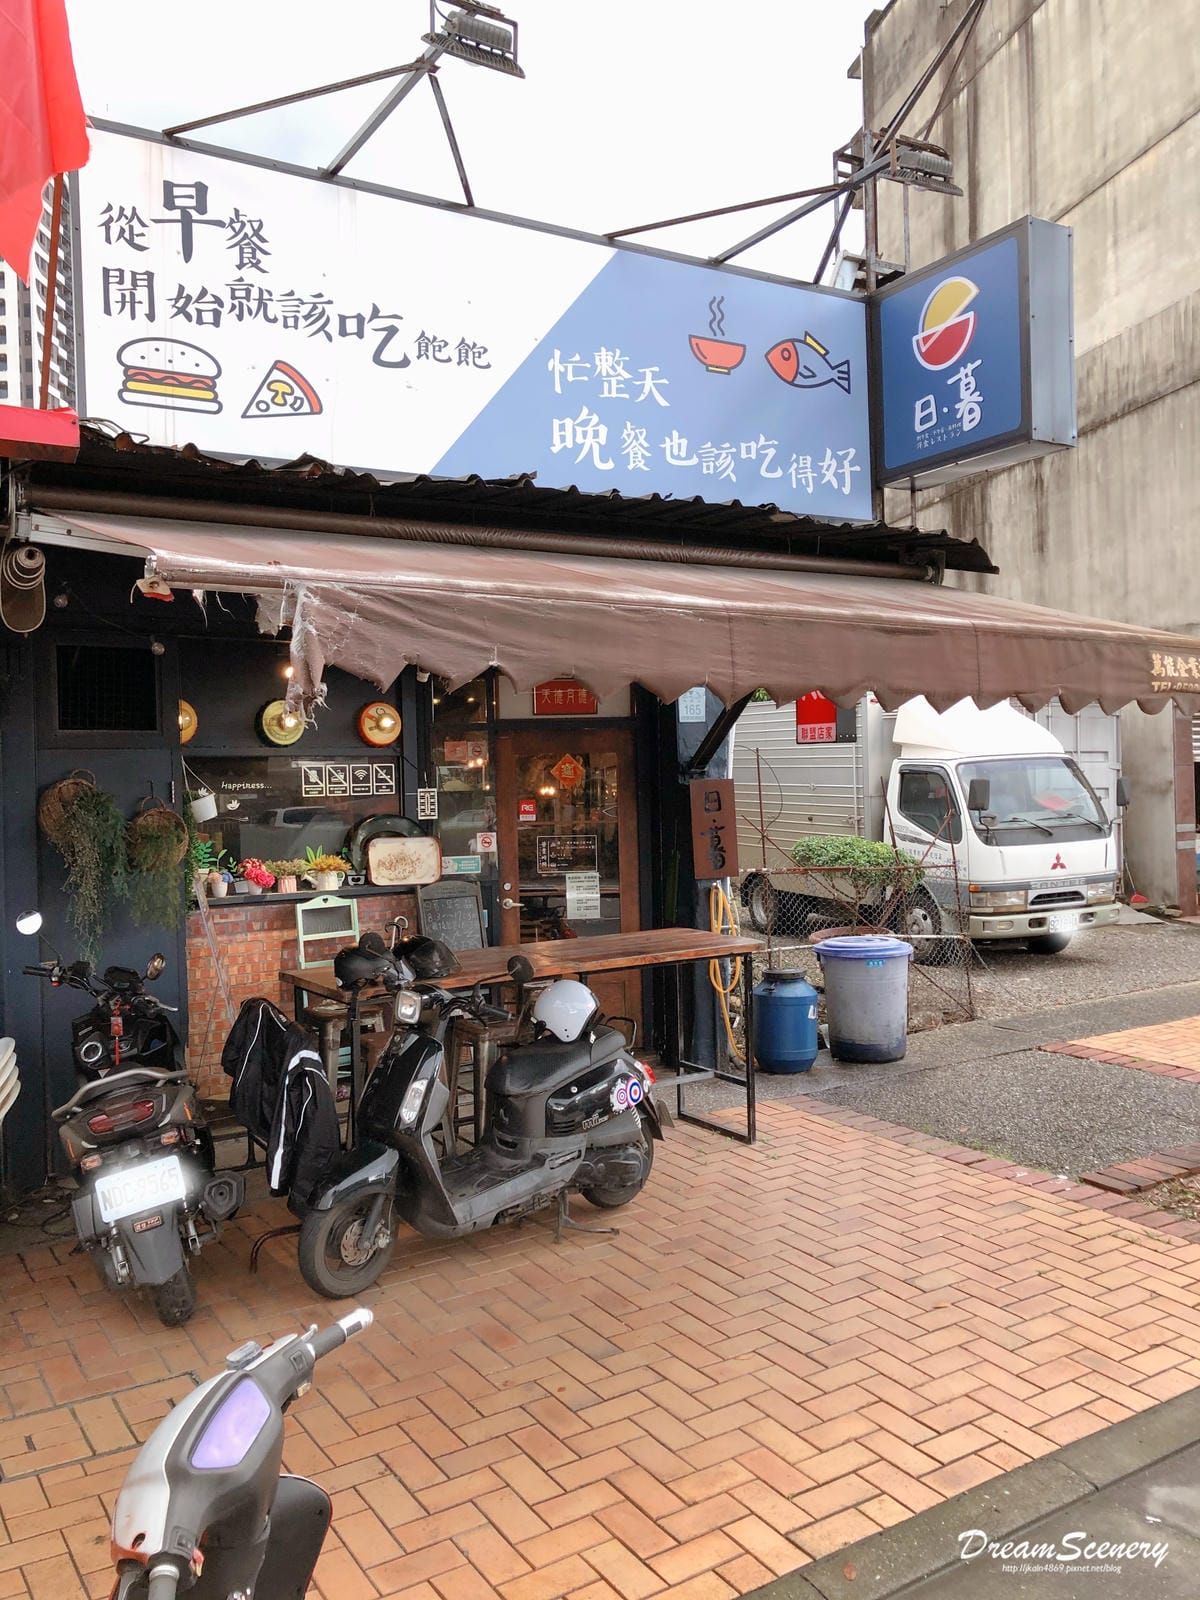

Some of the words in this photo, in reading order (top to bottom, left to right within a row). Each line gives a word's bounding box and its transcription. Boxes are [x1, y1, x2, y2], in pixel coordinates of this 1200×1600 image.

[97, 180, 272, 274] 從早餐
[102, 267, 492, 370] 開始就該吃飽飽
[548, 347, 670, 407] 忙整天
[550, 405, 862, 496] 晚餐也該吃得好
[684, 704, 702, 716] 165
[801, 726, 833, 740] 聯盟店家
